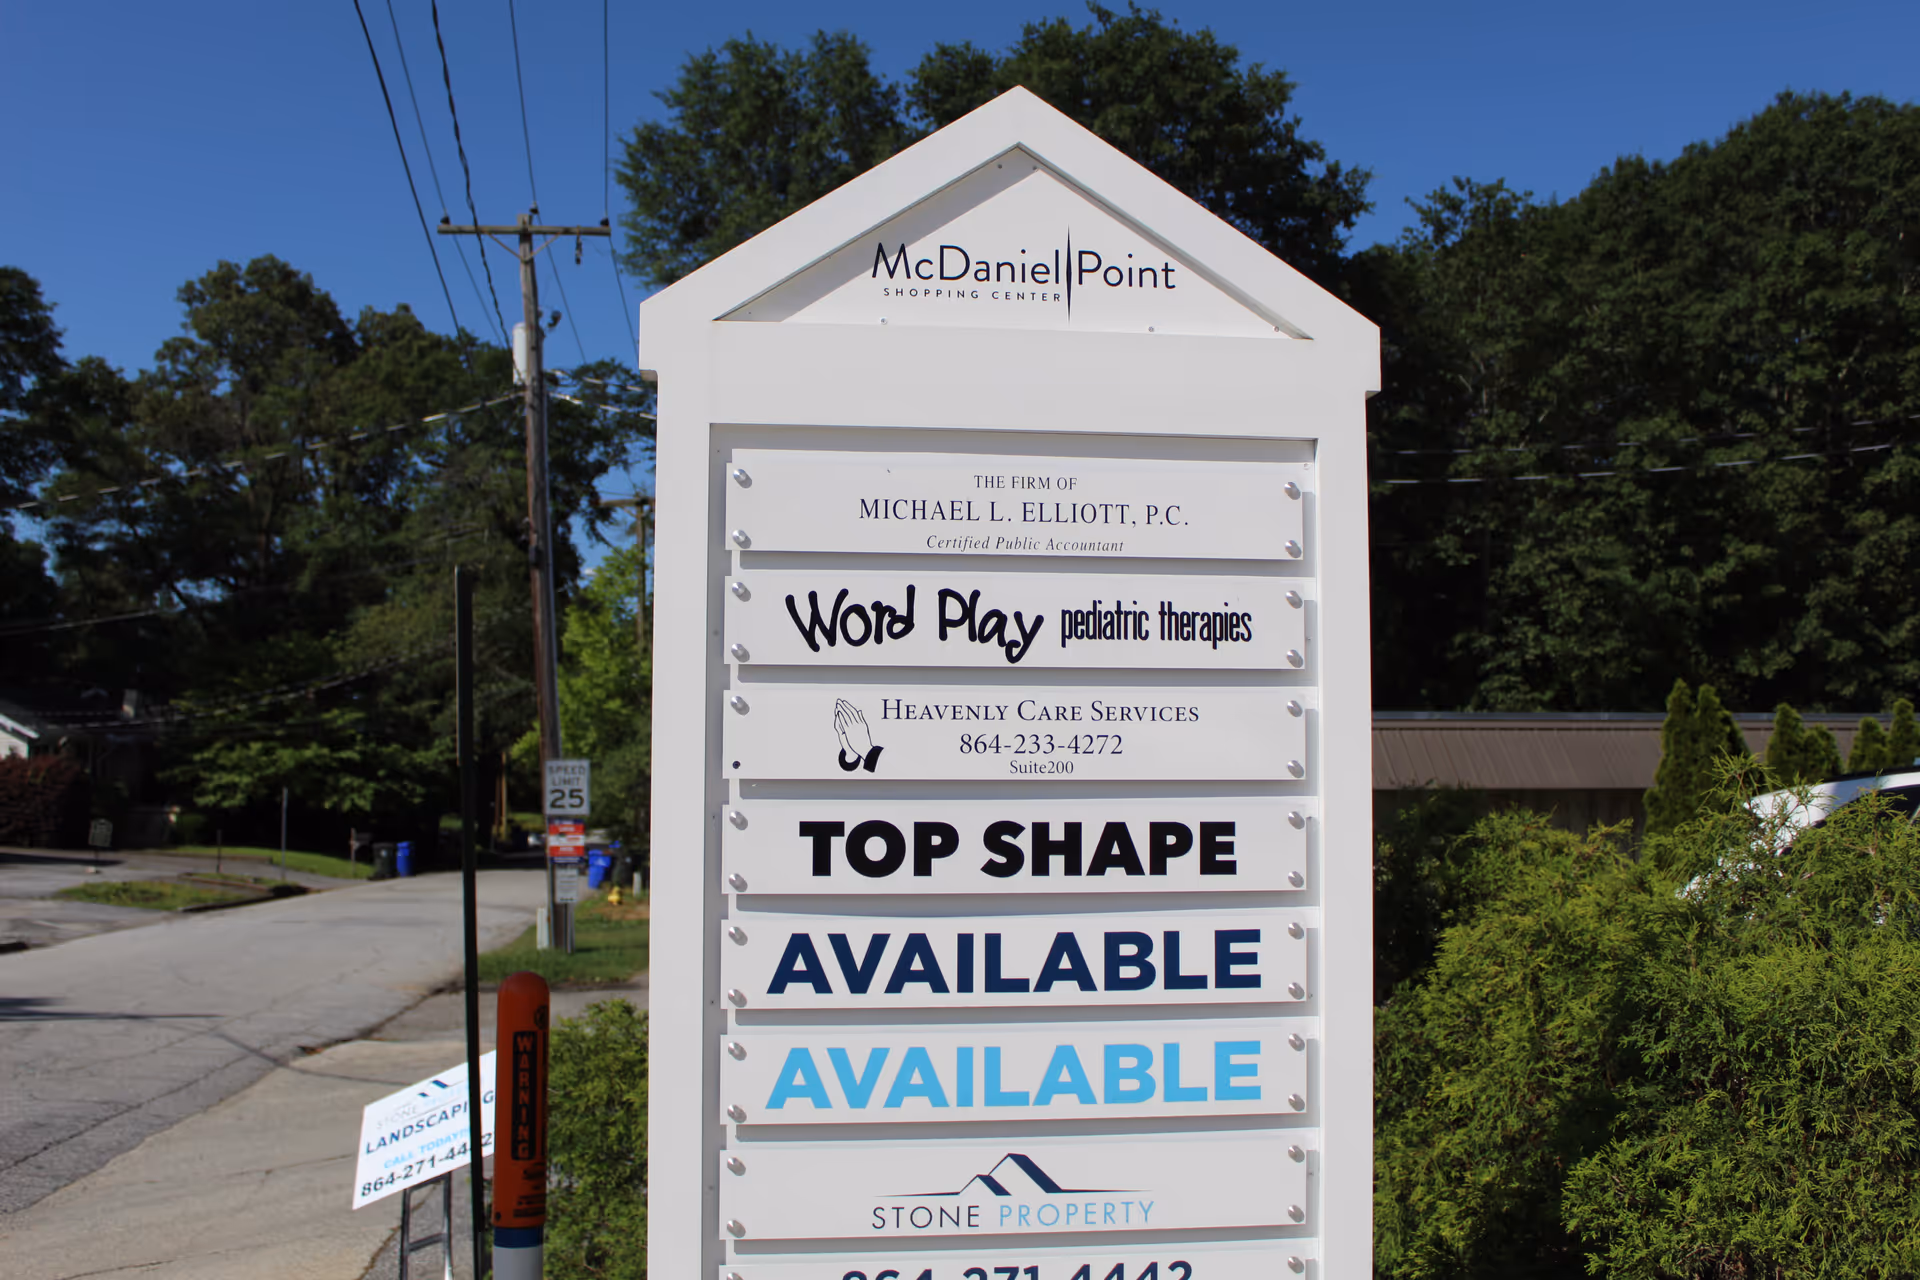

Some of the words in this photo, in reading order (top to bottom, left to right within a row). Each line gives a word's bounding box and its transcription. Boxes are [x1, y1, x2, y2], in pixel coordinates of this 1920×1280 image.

[872, 242, 1060, 284] McDaniel
[1078, 250, 1176, 289] Point
[883, 287, 979, 299] SHOPPING
[991, 290, 1061, 302] CENTER
[974, 475, 1005, 489] THE
[1012, 476, 1050, 490] FIRM
[1057, 477, 1077, 490] OF
[859, 498, 980, 521] MICHAEL
[989, 501, 1012, 522] L.
[1022, 502, 1137, 527] ELLIOTT,
[1146, 505, 1189, 526] P.C.
[926, 535, 990, 552] Certified
[996, 537, 1041, 551] Public
[1045, 538, 1124, 552] Accountant
[785, 584, 916, 652] Word
[938, 588, 1045, 664] Play
[1061, 599, 1150, 648] pediatric
[1158, 600, 1253, 650] therapies
[959, 733, 1123, 755] 864-233-4272
[549, 765, 586, 776] SPEED
[1009, 760, 1074, 774] Suite200
[552, 777, 581, 787] LIMIT
[550, 788, 585, 809] 25
[799, 820, 960, 878] TOP
[980, 820, 1238, 878] SHAPE
[766, 929, 1262, 994] AVAILABLE
[765, 1040, 1262, 1109] AVAILABLE
[516, 1034, 533, 1158] WARNING
[365, 1090, 494, 1155] LANDSCAPIG
[360, 1132, 493, 1198] 864-271-442
[383, 1150, 415, 1169] CALL
[872, 1205, 980, 1229] STONE
[1000, 1201, 1155, 1227] PROPERTY
